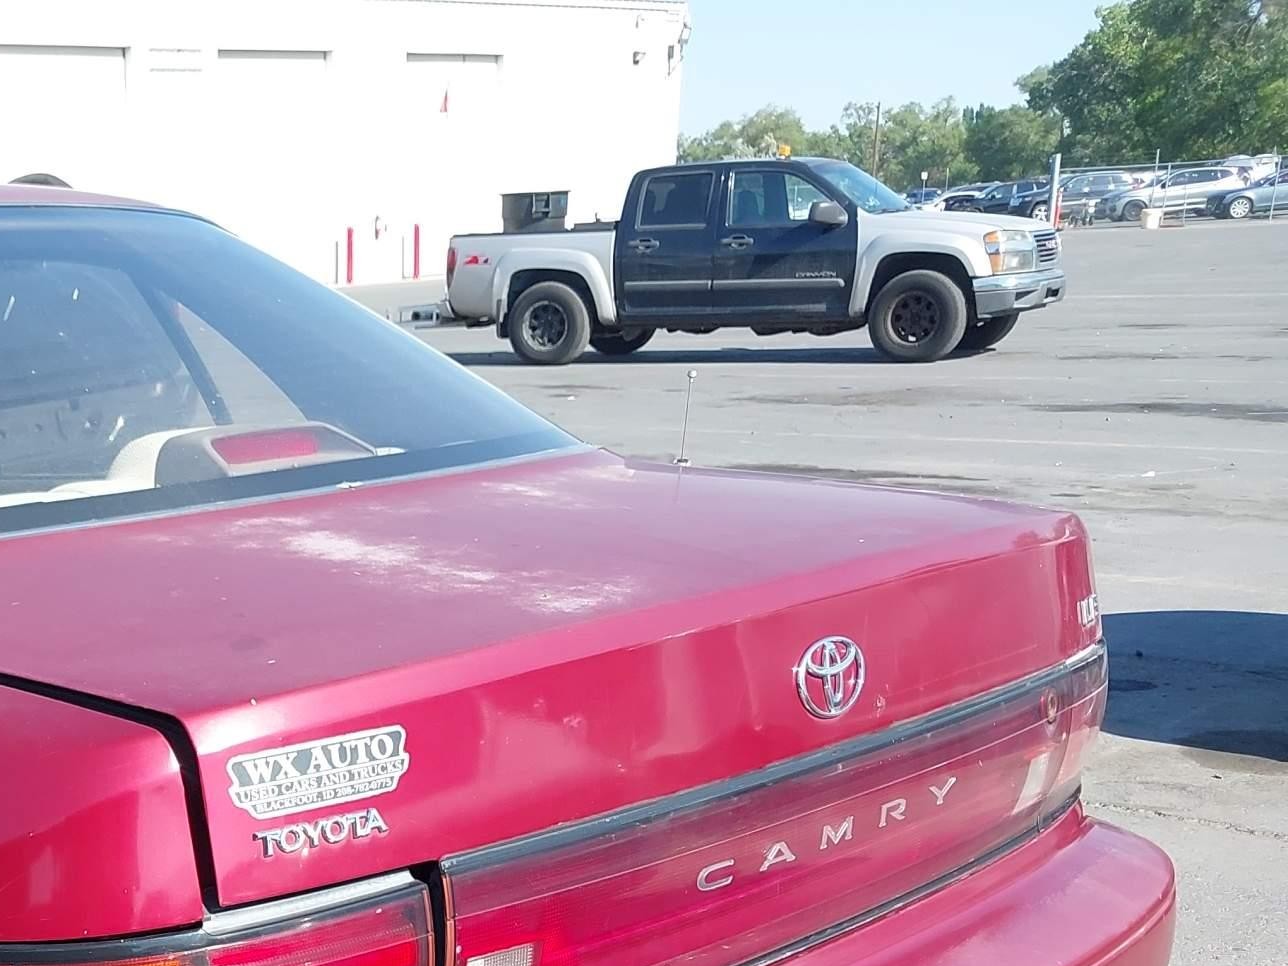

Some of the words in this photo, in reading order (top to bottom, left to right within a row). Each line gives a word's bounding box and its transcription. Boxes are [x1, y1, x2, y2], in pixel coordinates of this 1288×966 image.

[237, 785, 279, 803] USED
[281, 777, 318, 796] CARS
[320, 771, 350, 787] AND
[351, 760, 403, 779] TRUCKS
[242, 752, 300, 783] WX
[307, 734, 394, 774] AUTO
[323, 788, 335, 801] ID
[253, 808, 389, 858] TOYOTA
[696, 776, 957, 892] CAMRY
